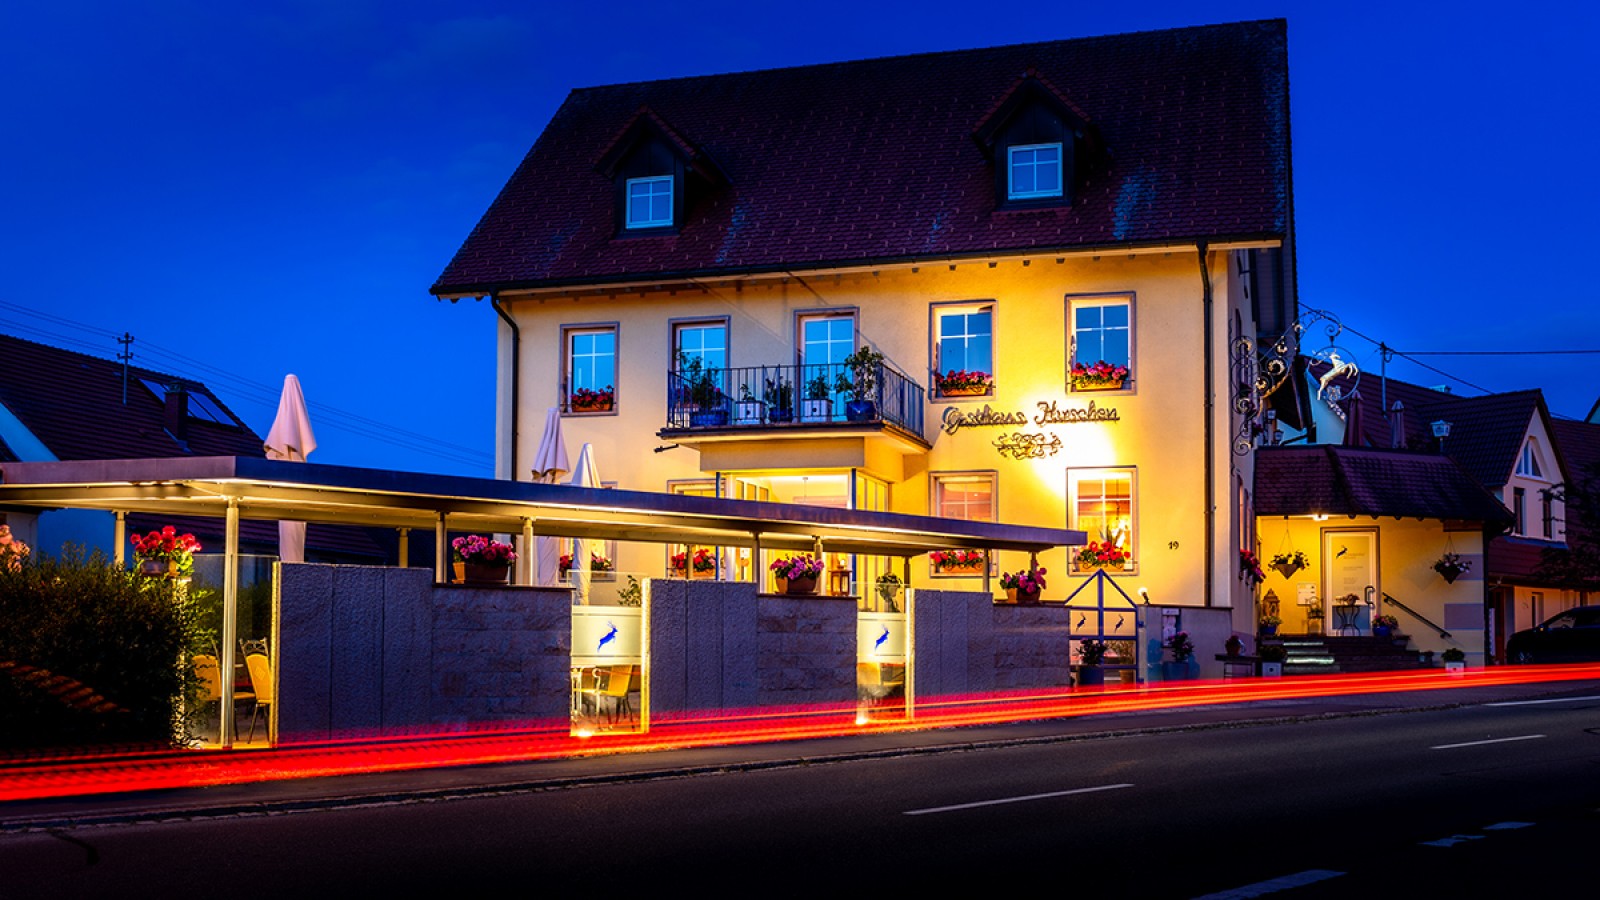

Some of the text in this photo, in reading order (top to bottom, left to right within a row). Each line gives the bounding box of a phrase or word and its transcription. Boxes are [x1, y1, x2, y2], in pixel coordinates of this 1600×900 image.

[941, 400, 1120, 435] Gasthaus Hirschen
[1168, 540, 1180, 550] 19
